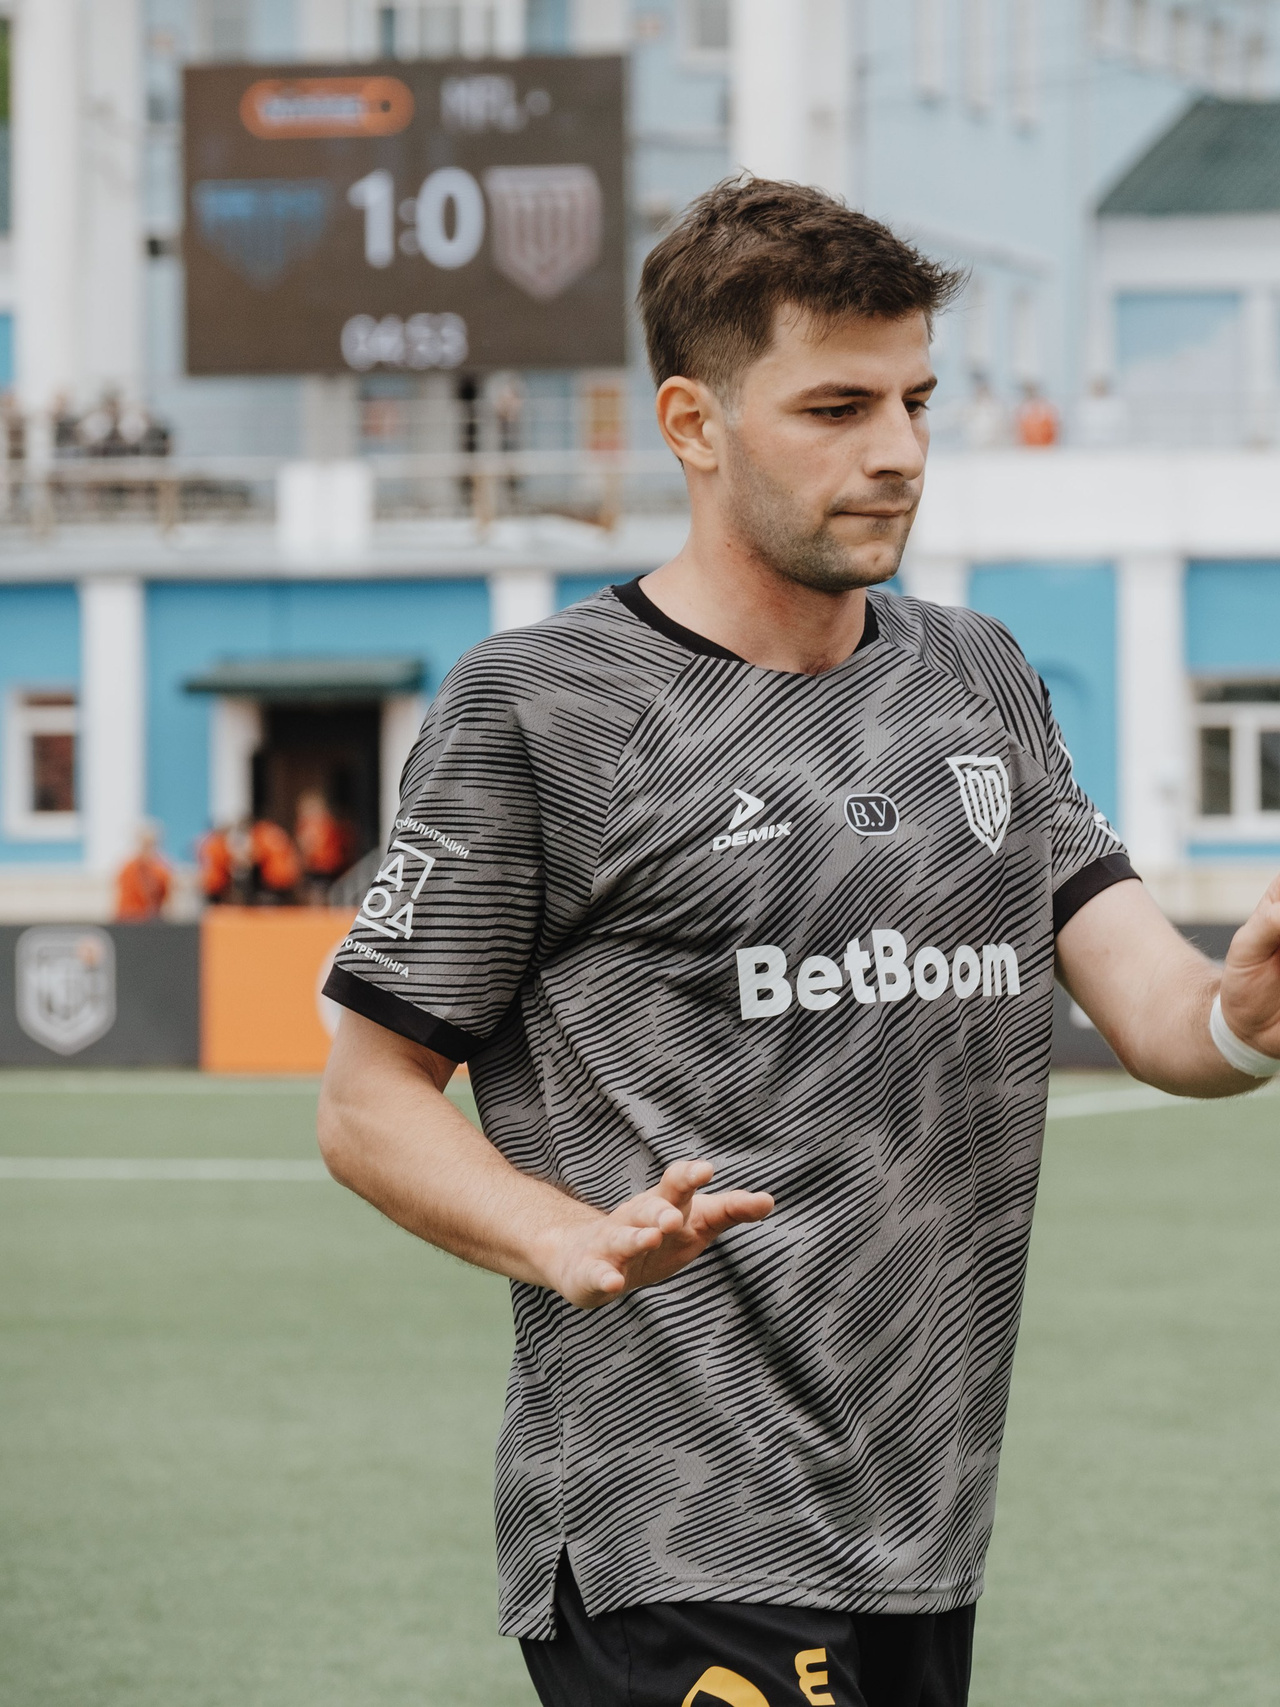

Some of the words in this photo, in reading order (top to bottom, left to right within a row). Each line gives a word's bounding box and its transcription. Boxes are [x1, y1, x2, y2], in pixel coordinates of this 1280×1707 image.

[713, 822, 792, 851] DEMIX
[353, 941, 409, 978] ТРЕНИНГА
[735, 929, 1021, 1021] BetBoom
